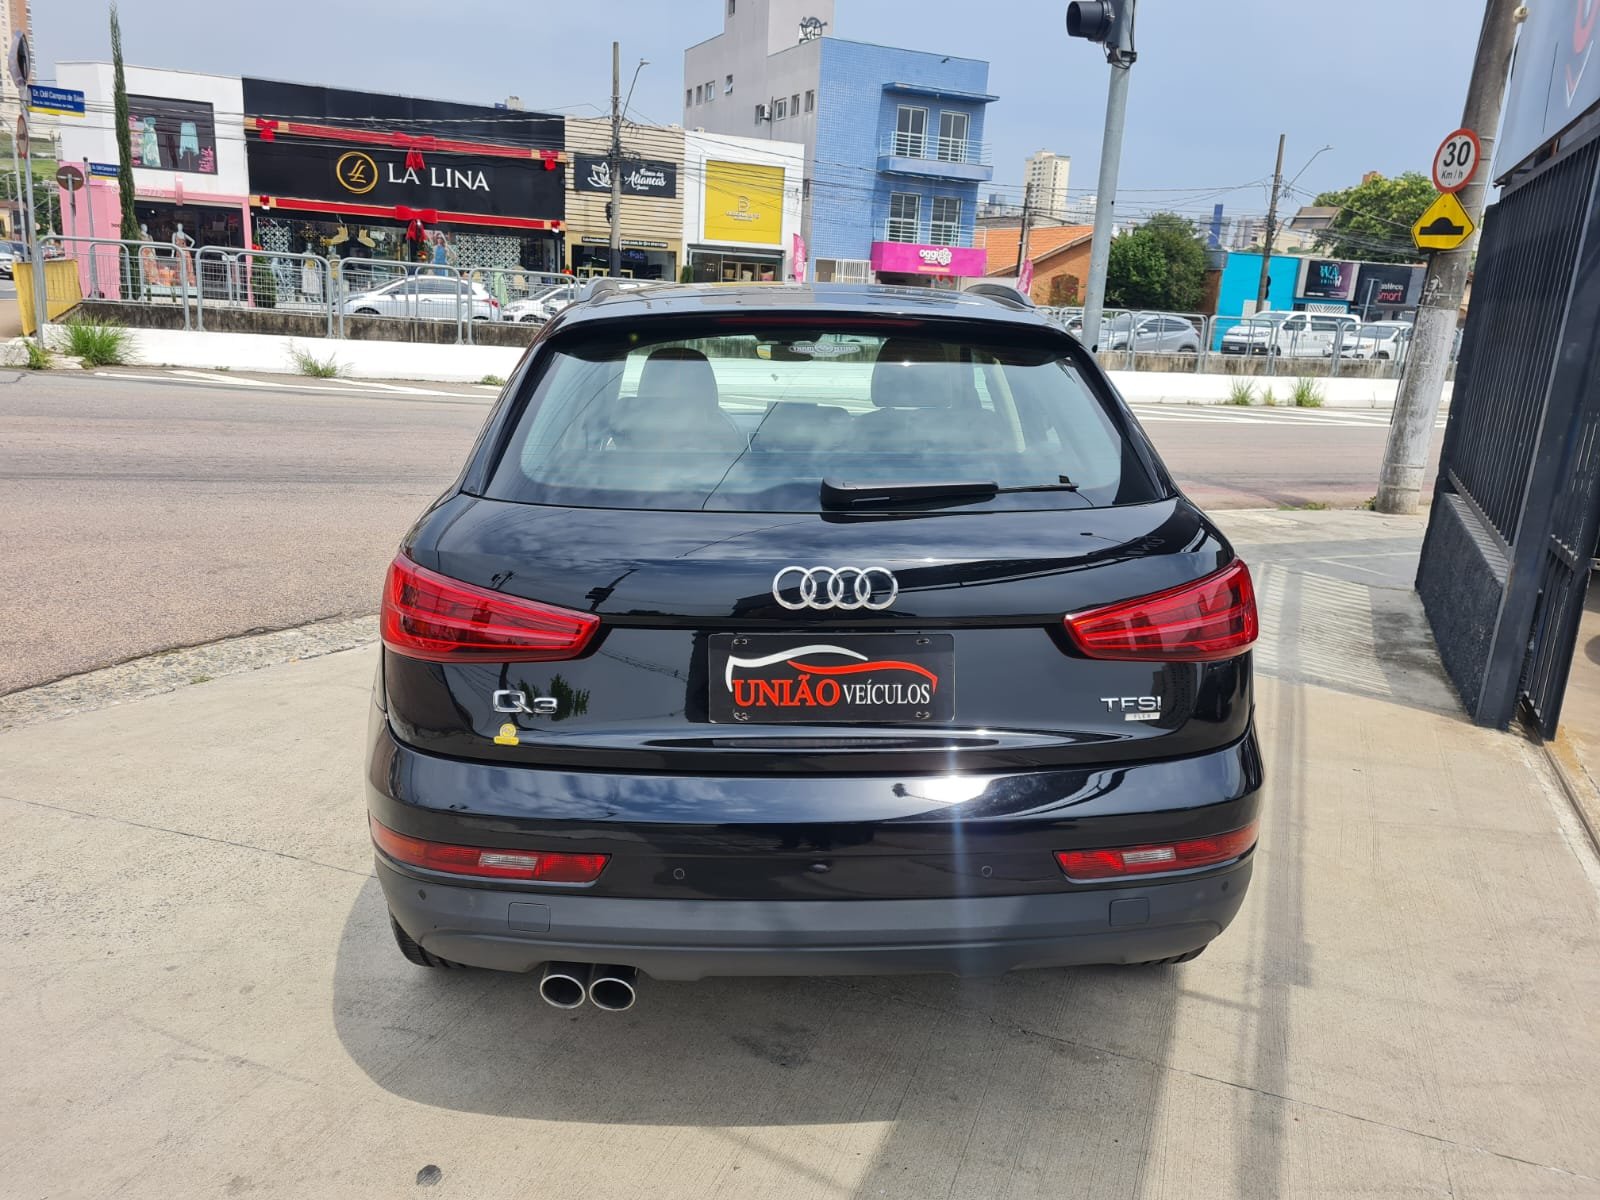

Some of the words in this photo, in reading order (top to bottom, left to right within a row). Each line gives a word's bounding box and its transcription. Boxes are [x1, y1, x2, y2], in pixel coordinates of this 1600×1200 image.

[1443, 141, 1471, 167] 30
[387, 162, 421, 185] LA
[430, 167, 490, 191] LINA
[919, 247, 939, 260] oggi
[493, 689, 557, 713] Q3
[732, 674, 840, 707] UNIÃO
[843, 679, 930, 705] VEÍCULOS
[1100, 696, 1161, 711] TFSI
